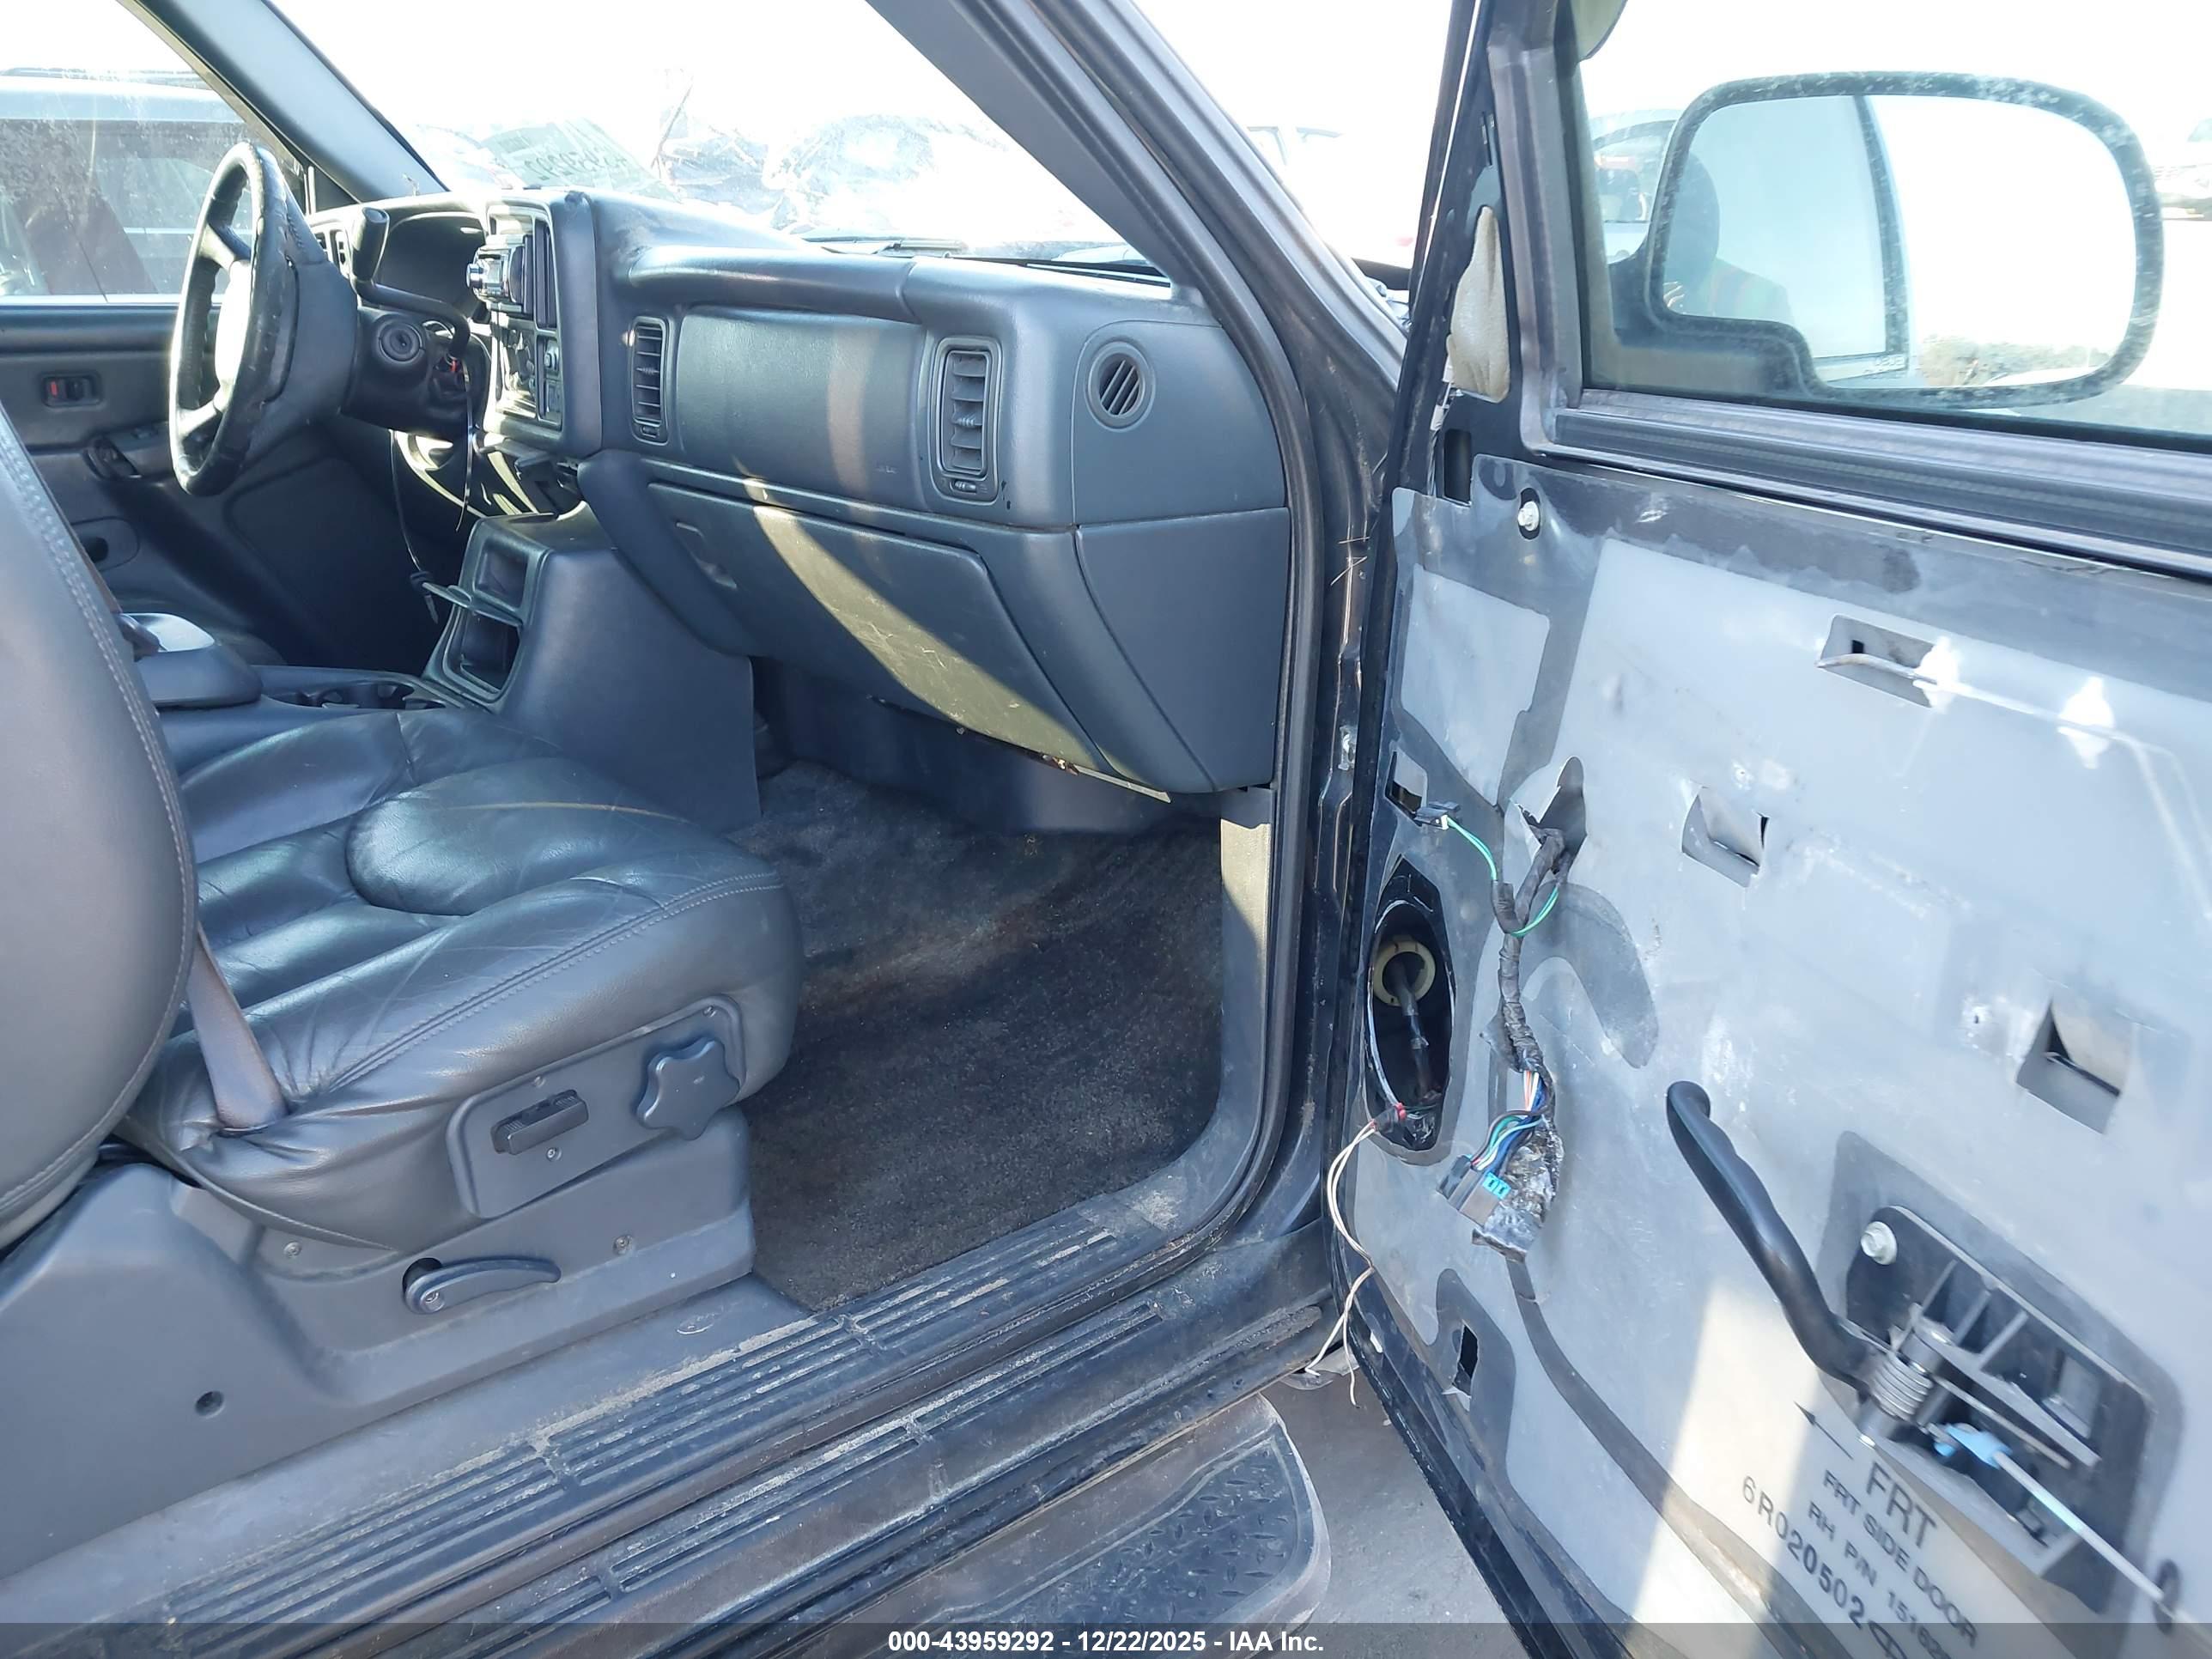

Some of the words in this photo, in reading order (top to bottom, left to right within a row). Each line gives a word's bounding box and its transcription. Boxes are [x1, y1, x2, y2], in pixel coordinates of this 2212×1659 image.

[1742, 1475, 1865, 1630] 6R020502
[1808, 1501, 1835, 1541] RH
[1844, 1540, 1877, 1588] P/N
[1823, 1469, 1861, 1516] FRT
[1863, 1513, 1910, 1572] SIDE
[1913, 1566, 1978, 1649] DOOR
[1867, 1461, 1936, 1548] FRT
